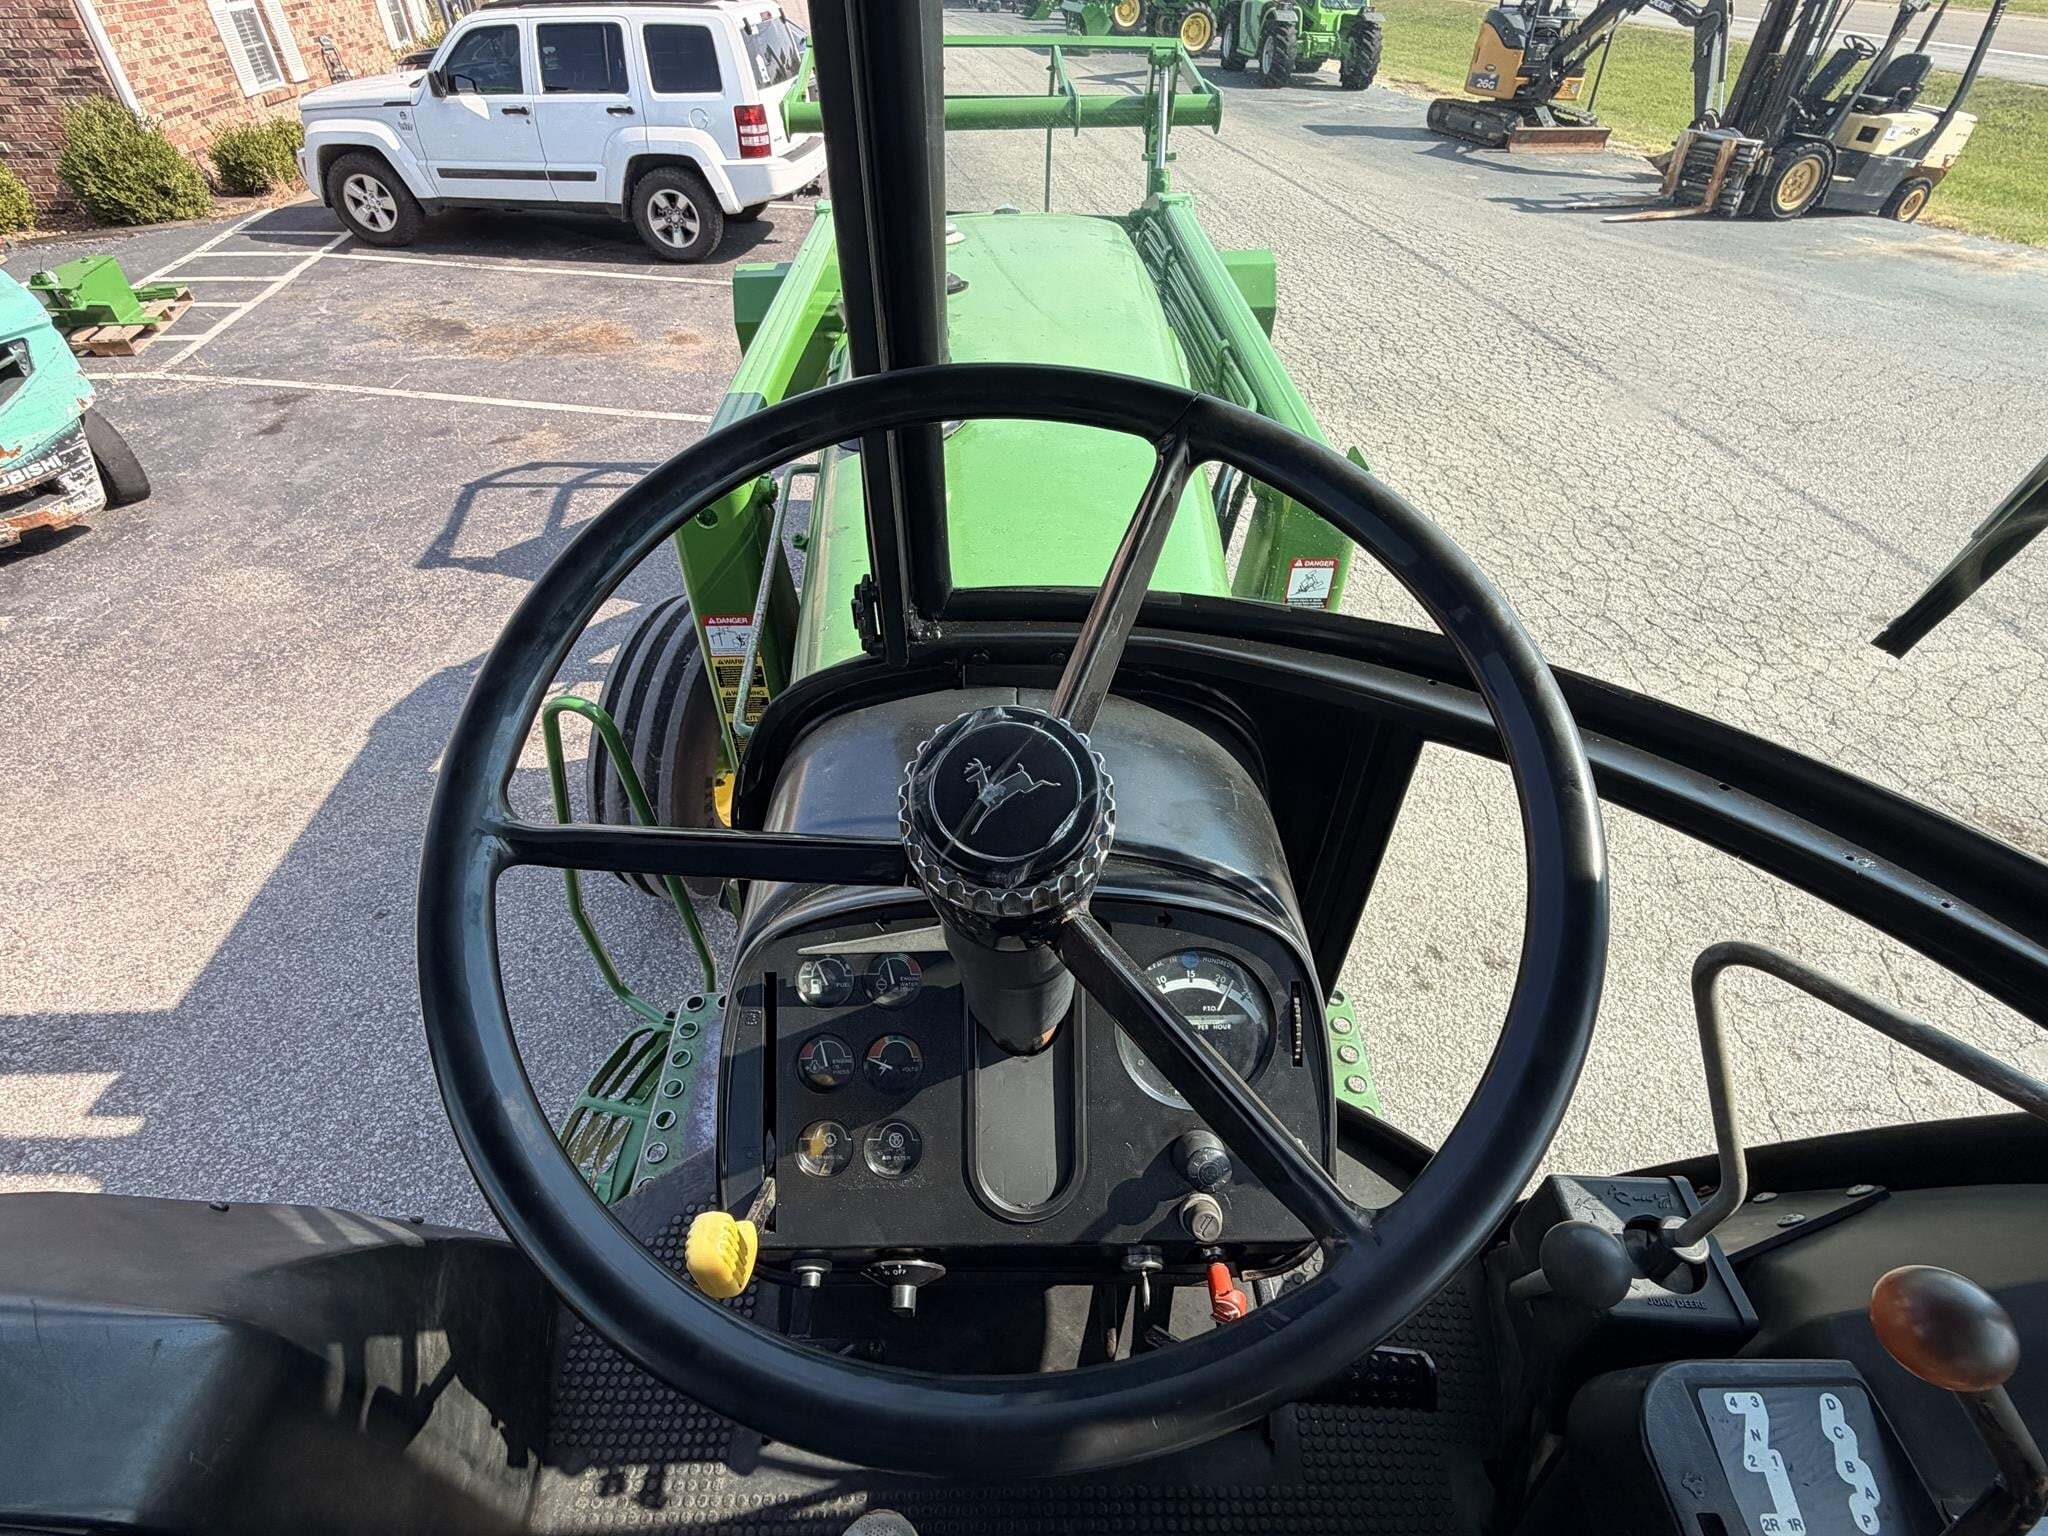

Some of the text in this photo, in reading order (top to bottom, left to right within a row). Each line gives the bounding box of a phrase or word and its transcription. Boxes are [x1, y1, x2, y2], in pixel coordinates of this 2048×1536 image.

[1156, 975, 1167, 984] 10
[1186, 970, 1196, 978] 15
[1215, 974, 1227, 983] 20
[1197, 1023, 1209, 1031] PER
[892, 1268, 907, 1276] OFF
[1646, 1297, 1708, 1310] JOHN DEERE
[1728, 1395, 1760, 1408] 4 3
[1825, 1397, 1837, 1411] D
[1751, 1427, 1762, 1442] N
[1833, 1426, 1845, 1440] C
[1748, 1454, 1779, 1468] 2 1
[1845, 1459, 1857, 1474] B
[1864, 1487, 1875, 1501] A
[1762, 1517, 1804, 1533] 2R 1R
[1861, 1514, 1873, 1529] P
